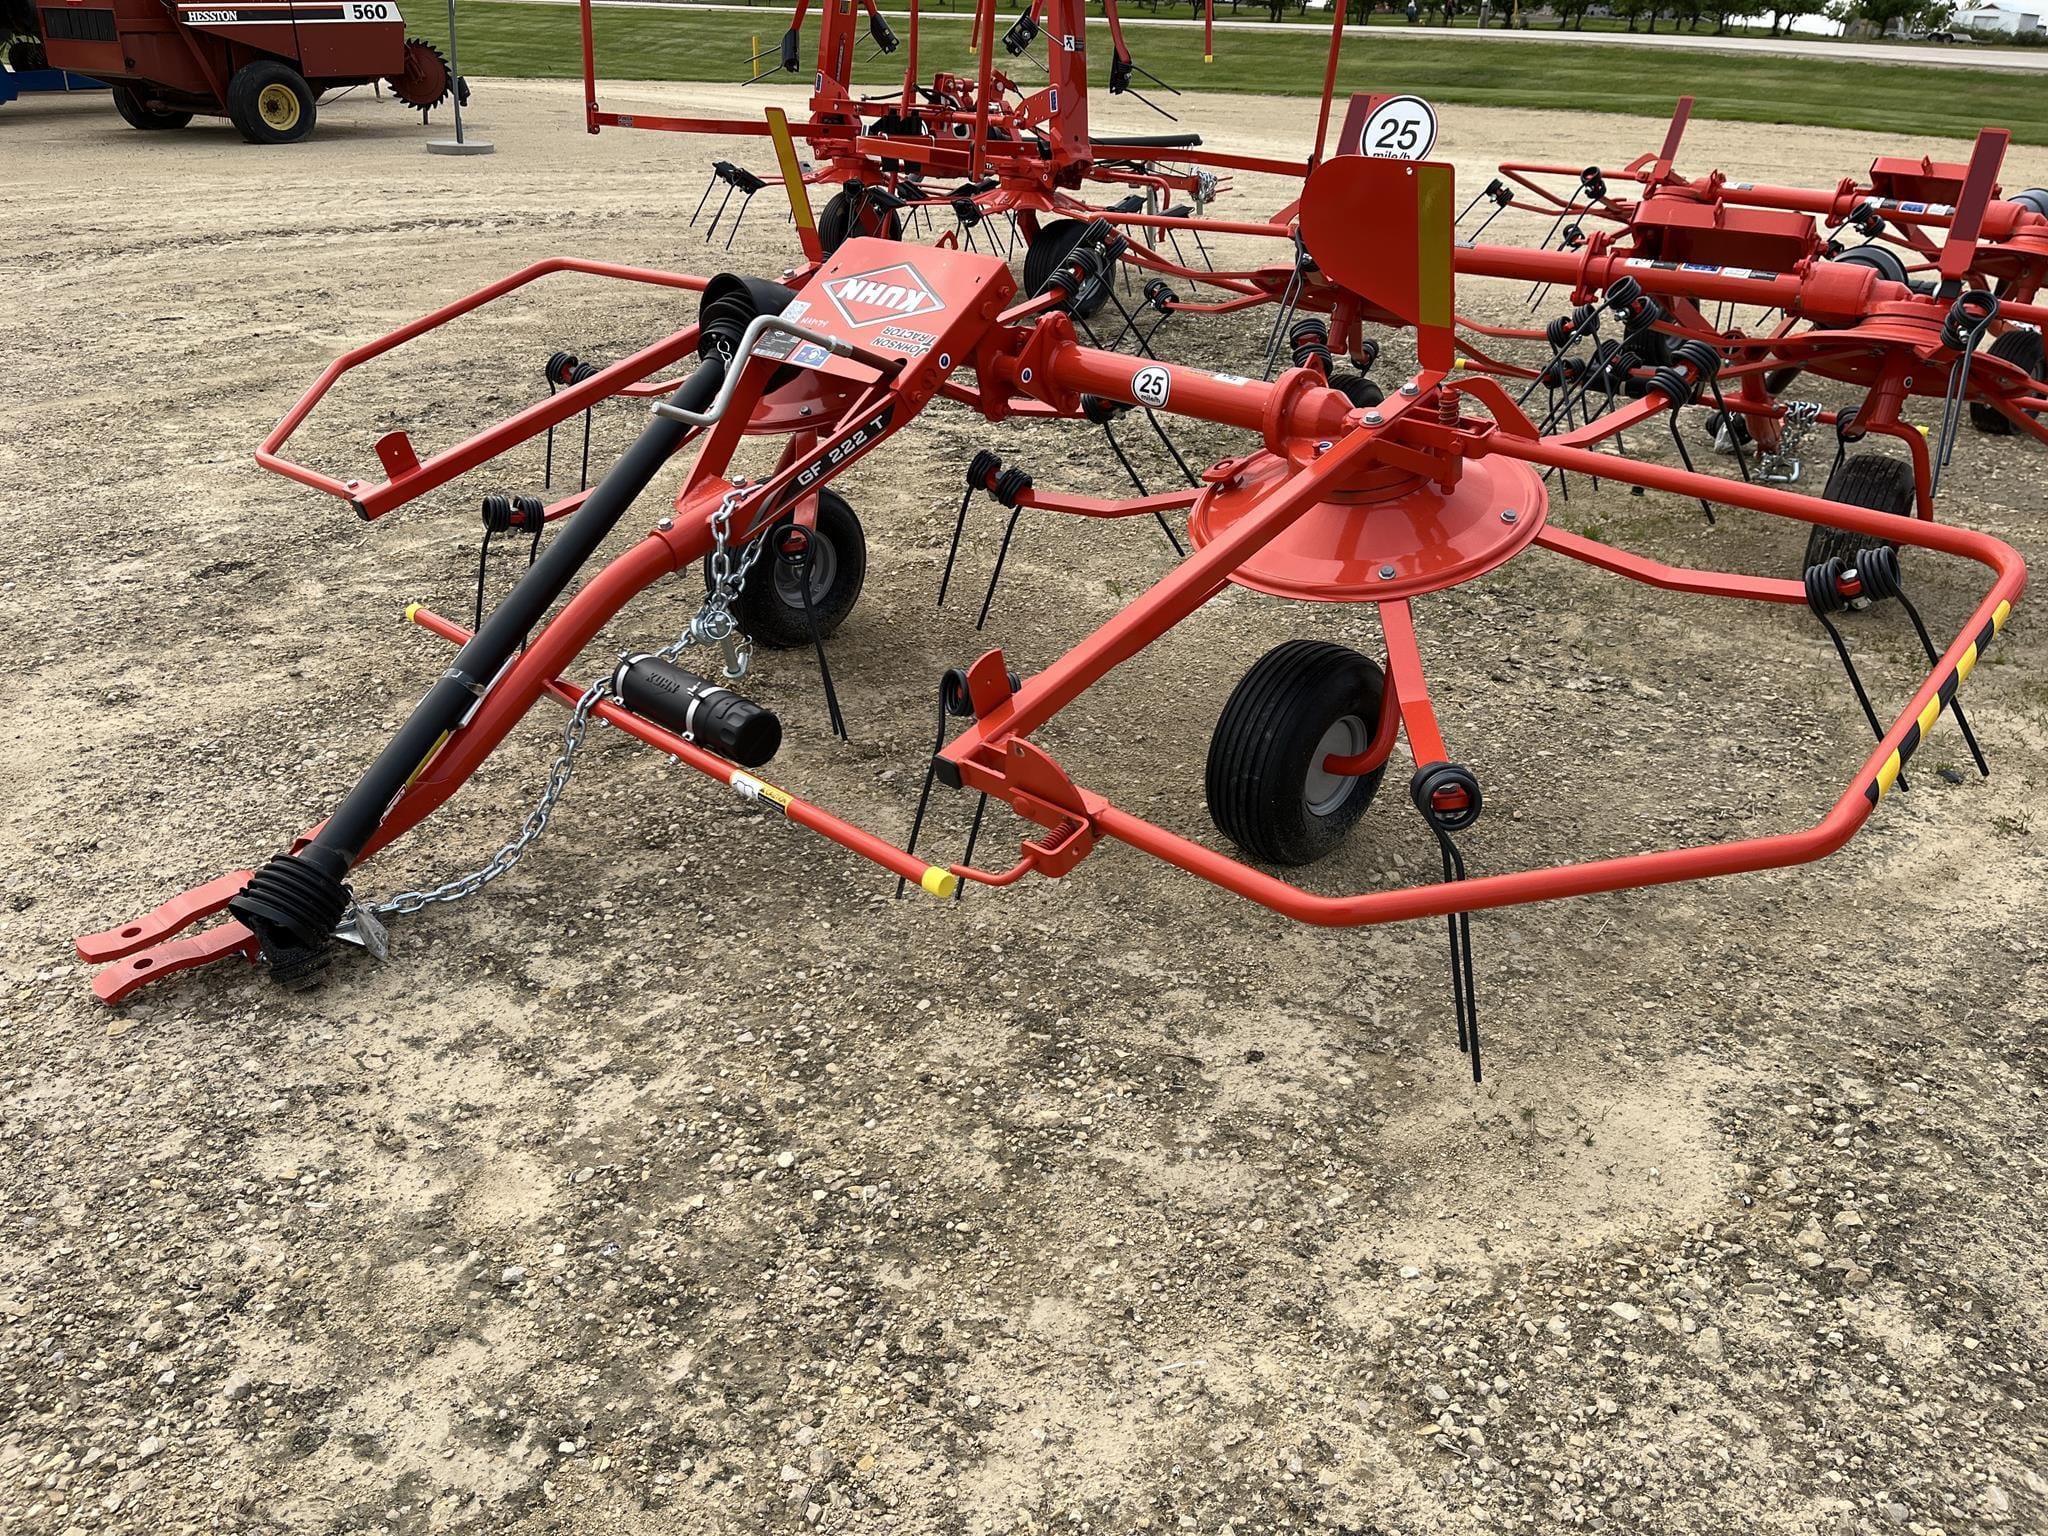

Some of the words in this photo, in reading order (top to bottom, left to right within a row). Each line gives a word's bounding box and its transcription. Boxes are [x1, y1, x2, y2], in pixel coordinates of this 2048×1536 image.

[187, 10, 238, 22] HESSTON
[352, 4, 388, 20] 560
[1374, 117, 1421, 151] 25
[835, 277, 929, 313] KUHN
[872, 337, 929, 357] JOHNSON
[882, 327, 938, 347] TRACTOR
[1140, 374, 1164, 395] 25
[797, 460, 822, 486] GF
[828, 430, 868, 464] 222
[869, 415, 883, 430] T
[646, 672, 681, 694] KUHN
